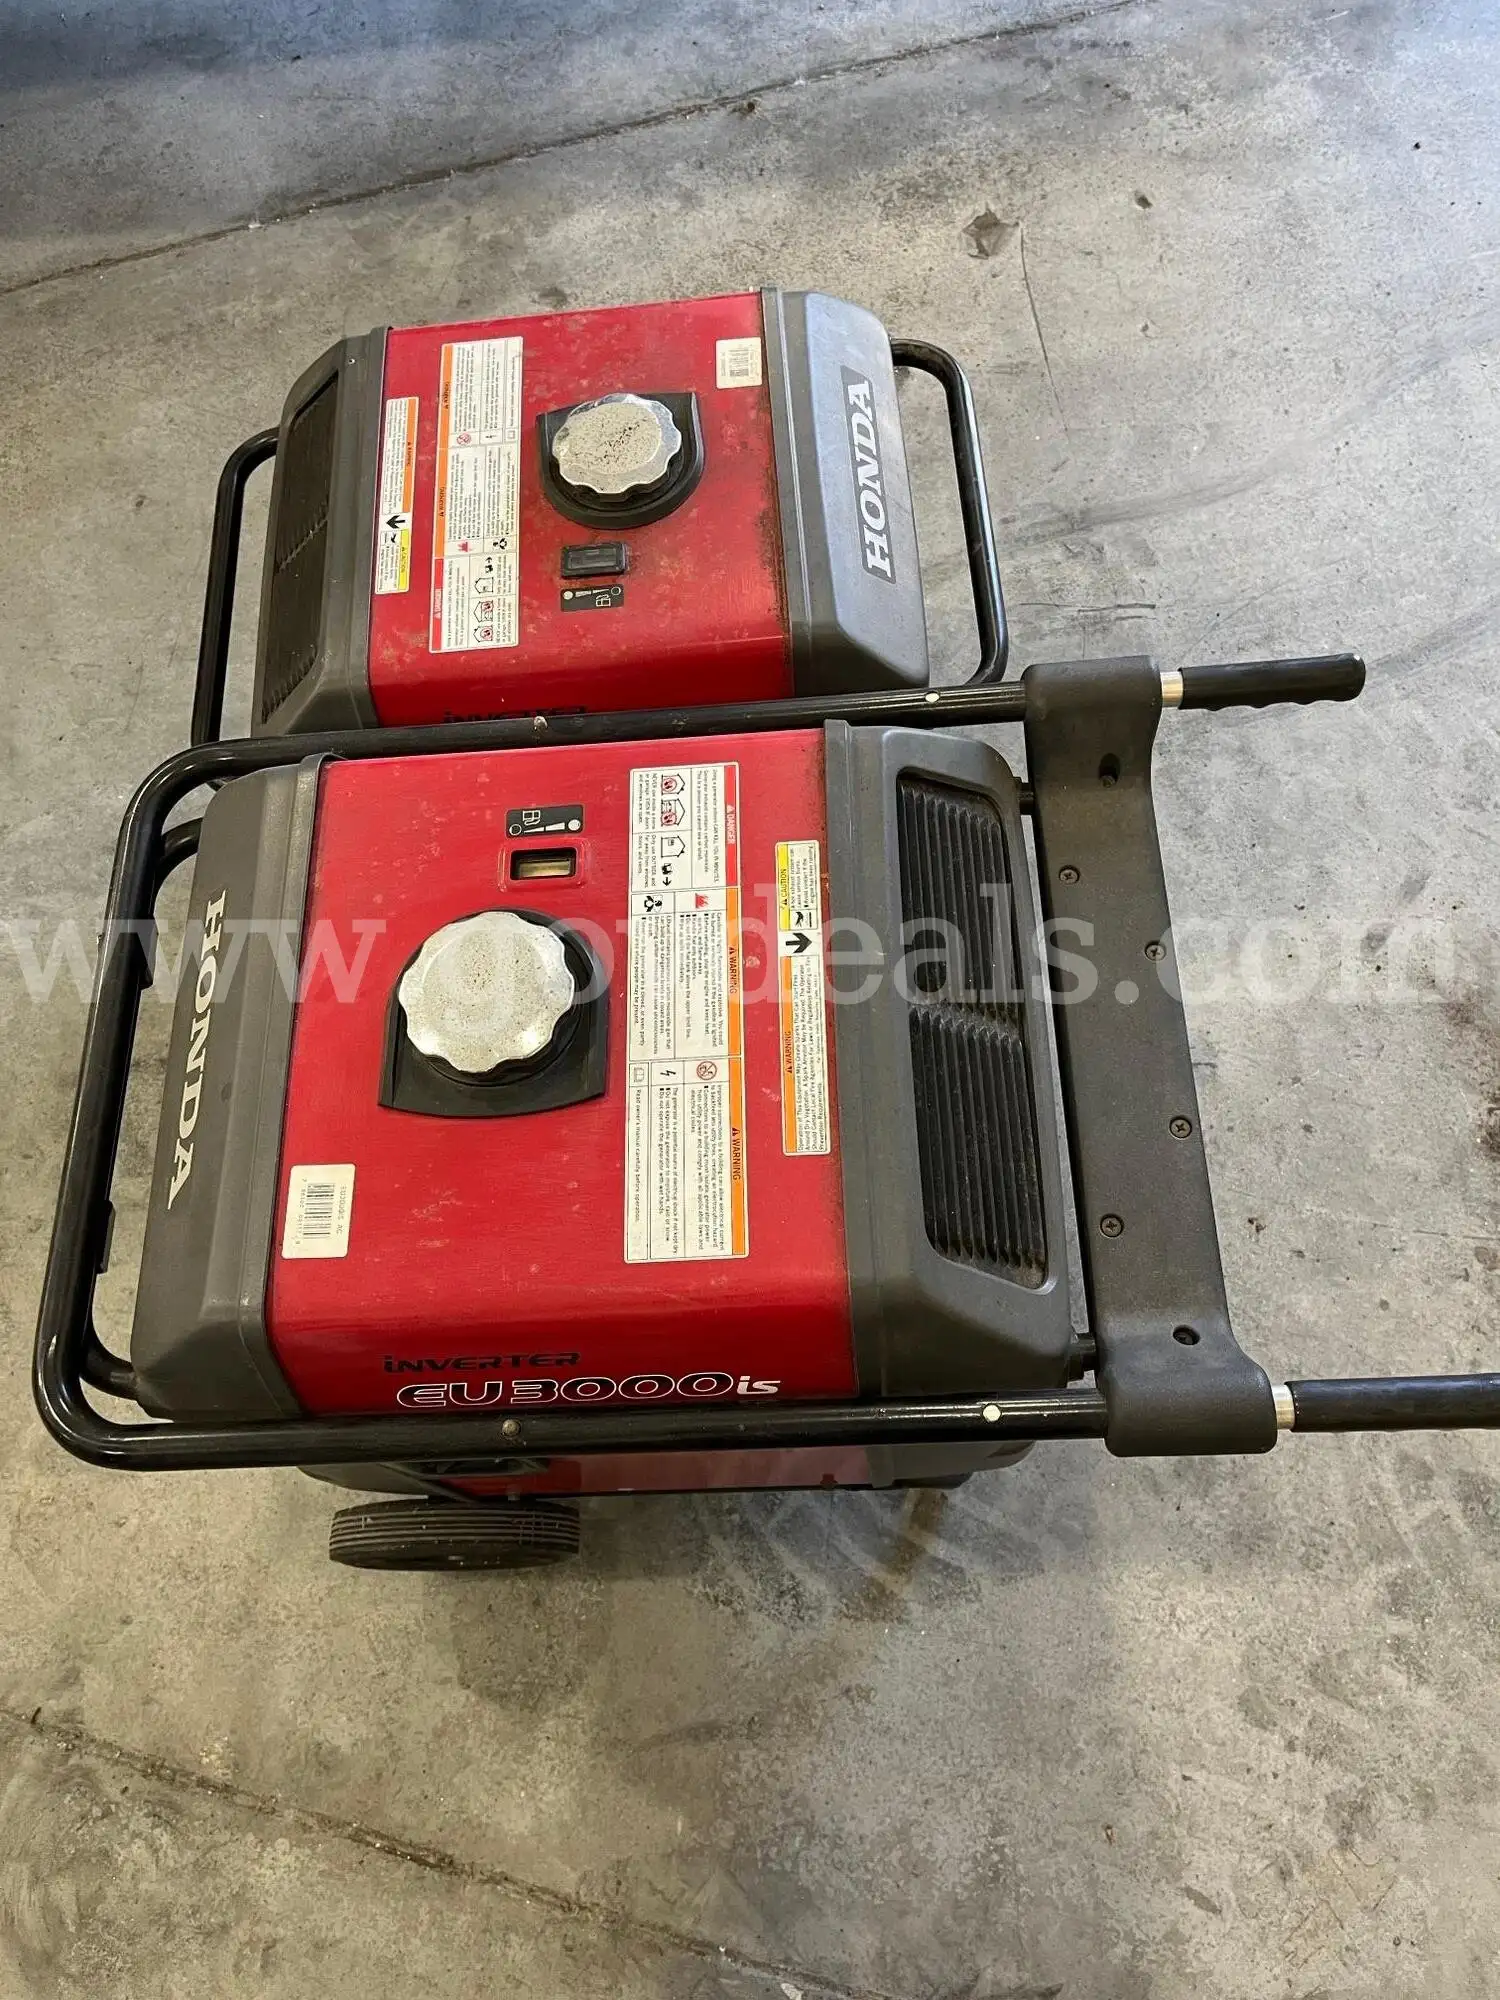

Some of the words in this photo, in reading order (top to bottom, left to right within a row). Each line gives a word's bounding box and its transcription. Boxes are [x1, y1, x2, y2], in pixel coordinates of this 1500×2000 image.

[848, 380, 892, 578] HONDA
[729, 956, 737, 993] WARNING
[167, 889, 227, 1211] HONDA
[784, 1031, 792, 1064] WARNING
[732, 1138, 740, 1180] WARNING
[396, 1371, 782, 1408] EU3000is
